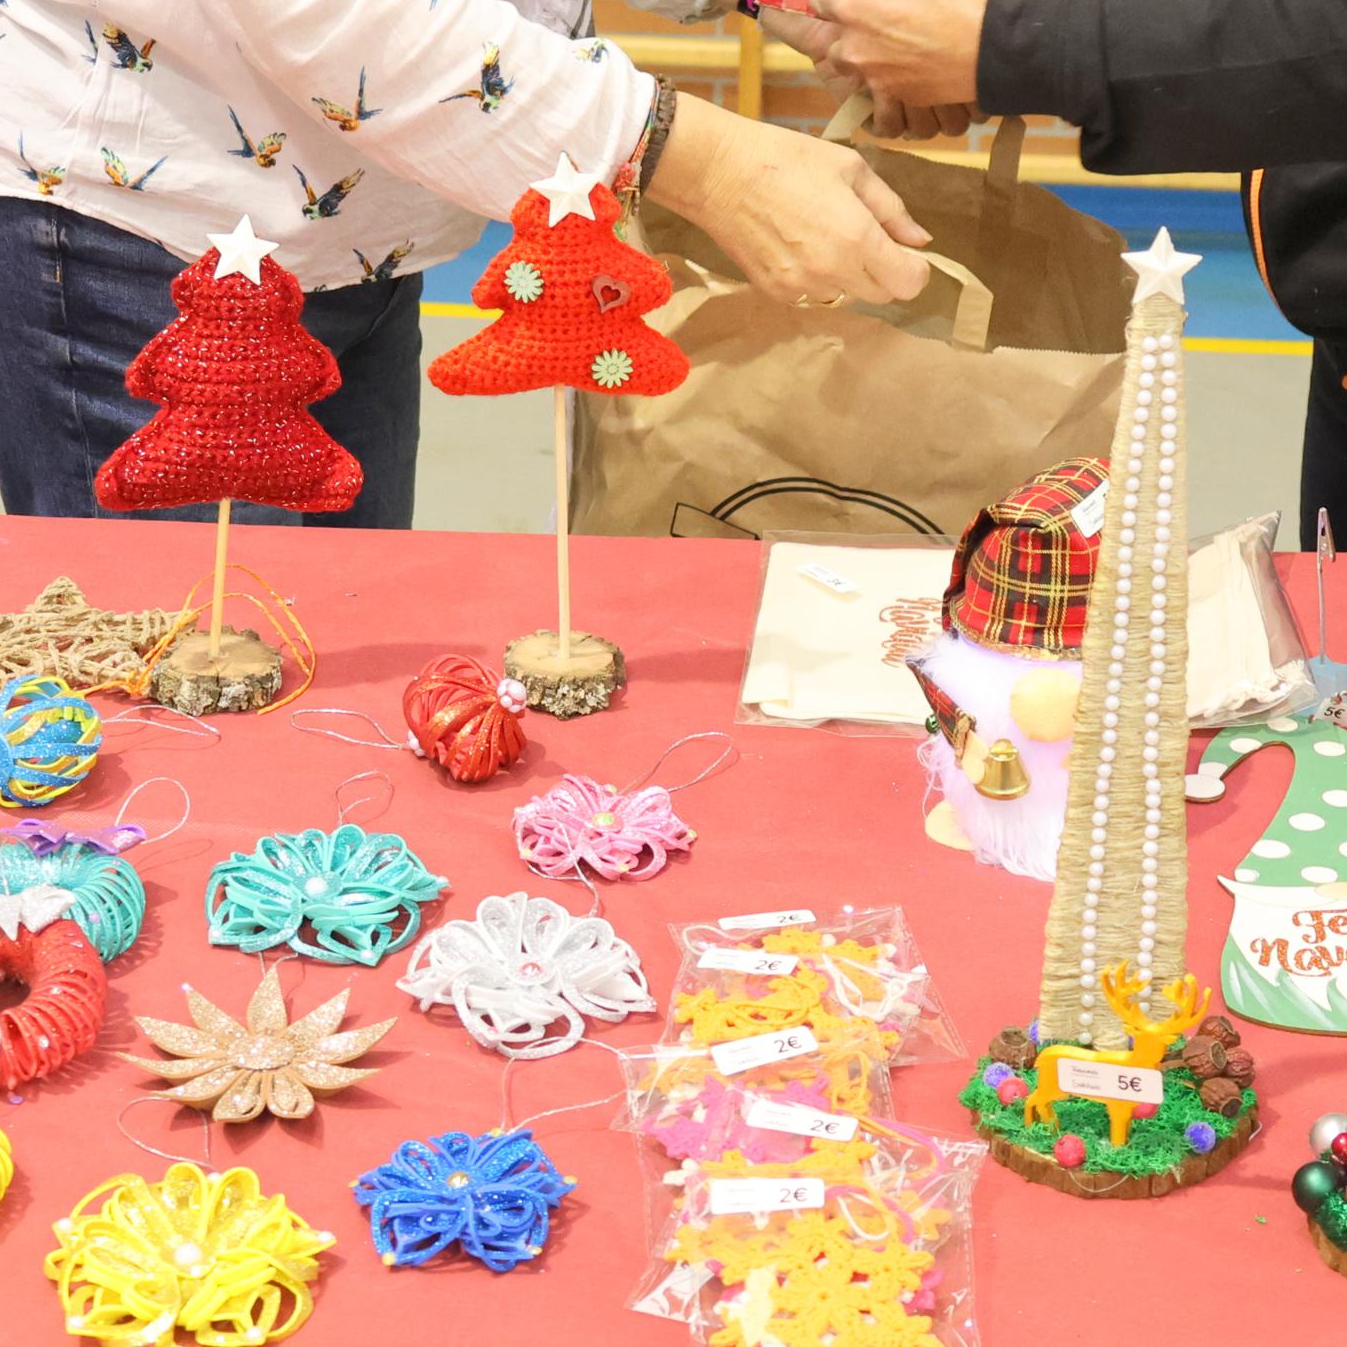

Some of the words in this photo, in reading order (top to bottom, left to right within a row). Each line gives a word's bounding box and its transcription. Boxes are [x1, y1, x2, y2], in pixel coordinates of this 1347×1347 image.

[1324, 705, 1346, 719] 5€
[777, 914, 803, 923] 2€
[754, 959, 783, 971] 2€
[773, 1035, 802, 1053] 2€
[1117, 1075, 1143, 1093] 5€
[810, 1119, 839, 1134] 2€
[779, 1187, 808, 1203] 2€
